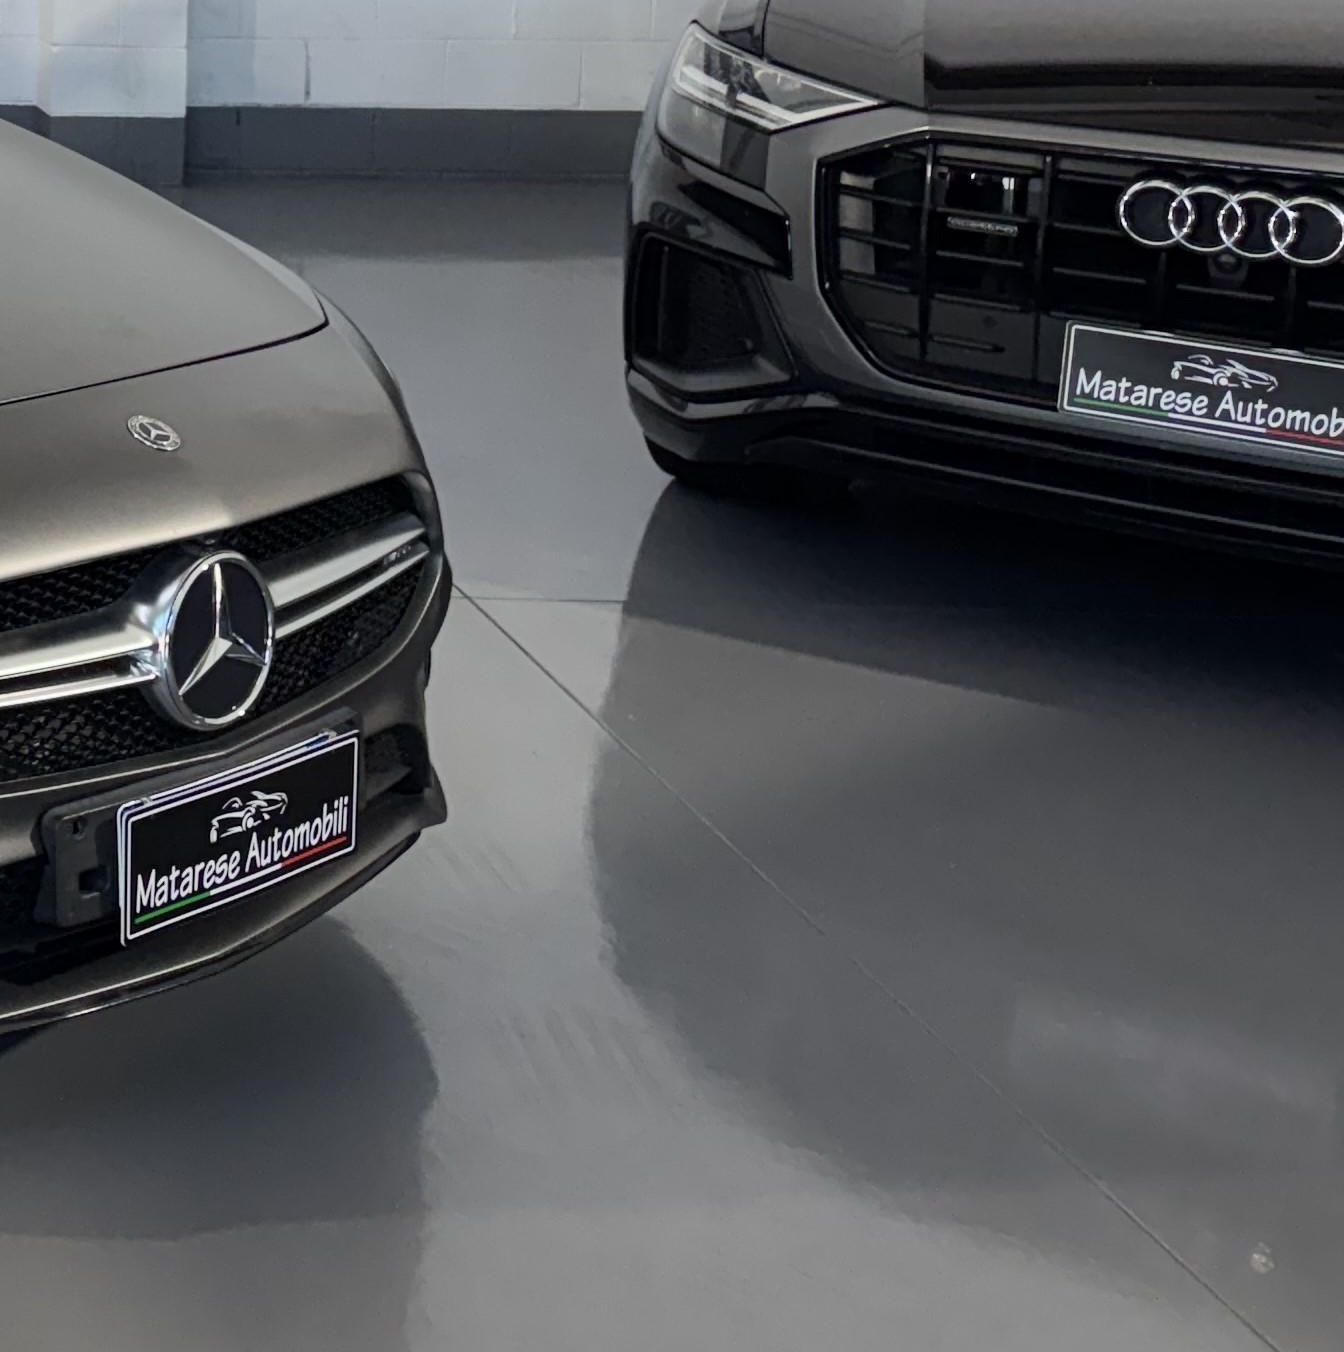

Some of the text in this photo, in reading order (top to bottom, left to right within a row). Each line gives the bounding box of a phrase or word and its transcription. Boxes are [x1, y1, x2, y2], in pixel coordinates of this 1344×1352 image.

[1075, 367, 1344, 437] Matarese Automob
[135, 796, 349, 913] Matarese Automobili
